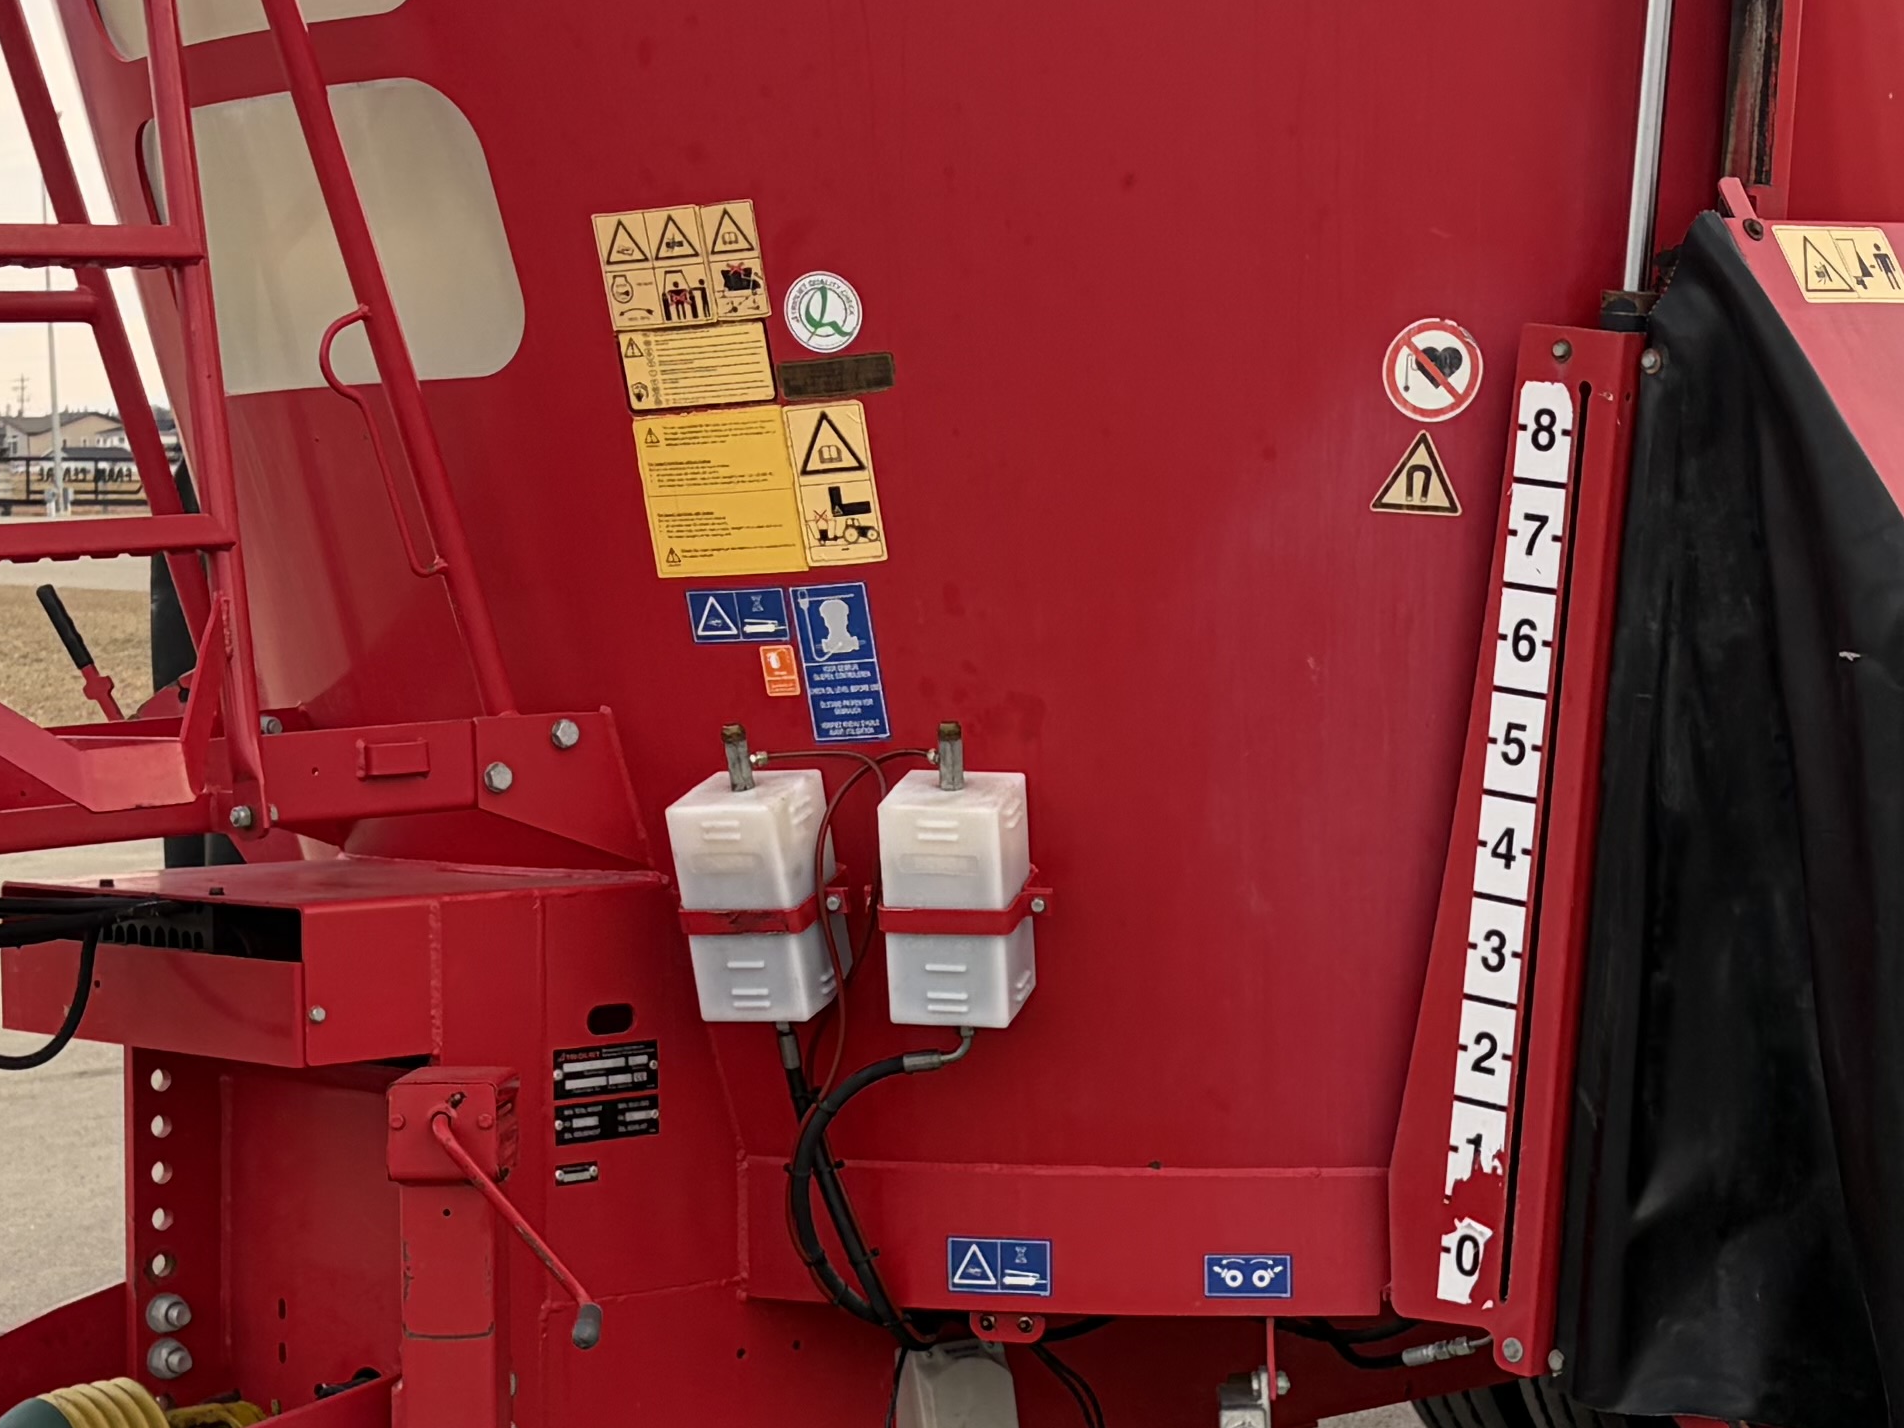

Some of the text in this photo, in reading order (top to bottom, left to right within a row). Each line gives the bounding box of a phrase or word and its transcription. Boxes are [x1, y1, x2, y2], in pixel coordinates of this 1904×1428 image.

[1531, 408, 1557, 452] 8
[1523, 512, 1549, 556] 7
[1511, 618, 1538, 663] 6
[1500, 722, 1528, 766] 5
[1491, 827, 1517, 870] 4
[1481, 929, 1507, 973] 3
[1471, 1031, 1499, 1076] 2
[1456, 1234, 1480, 1277] 0
